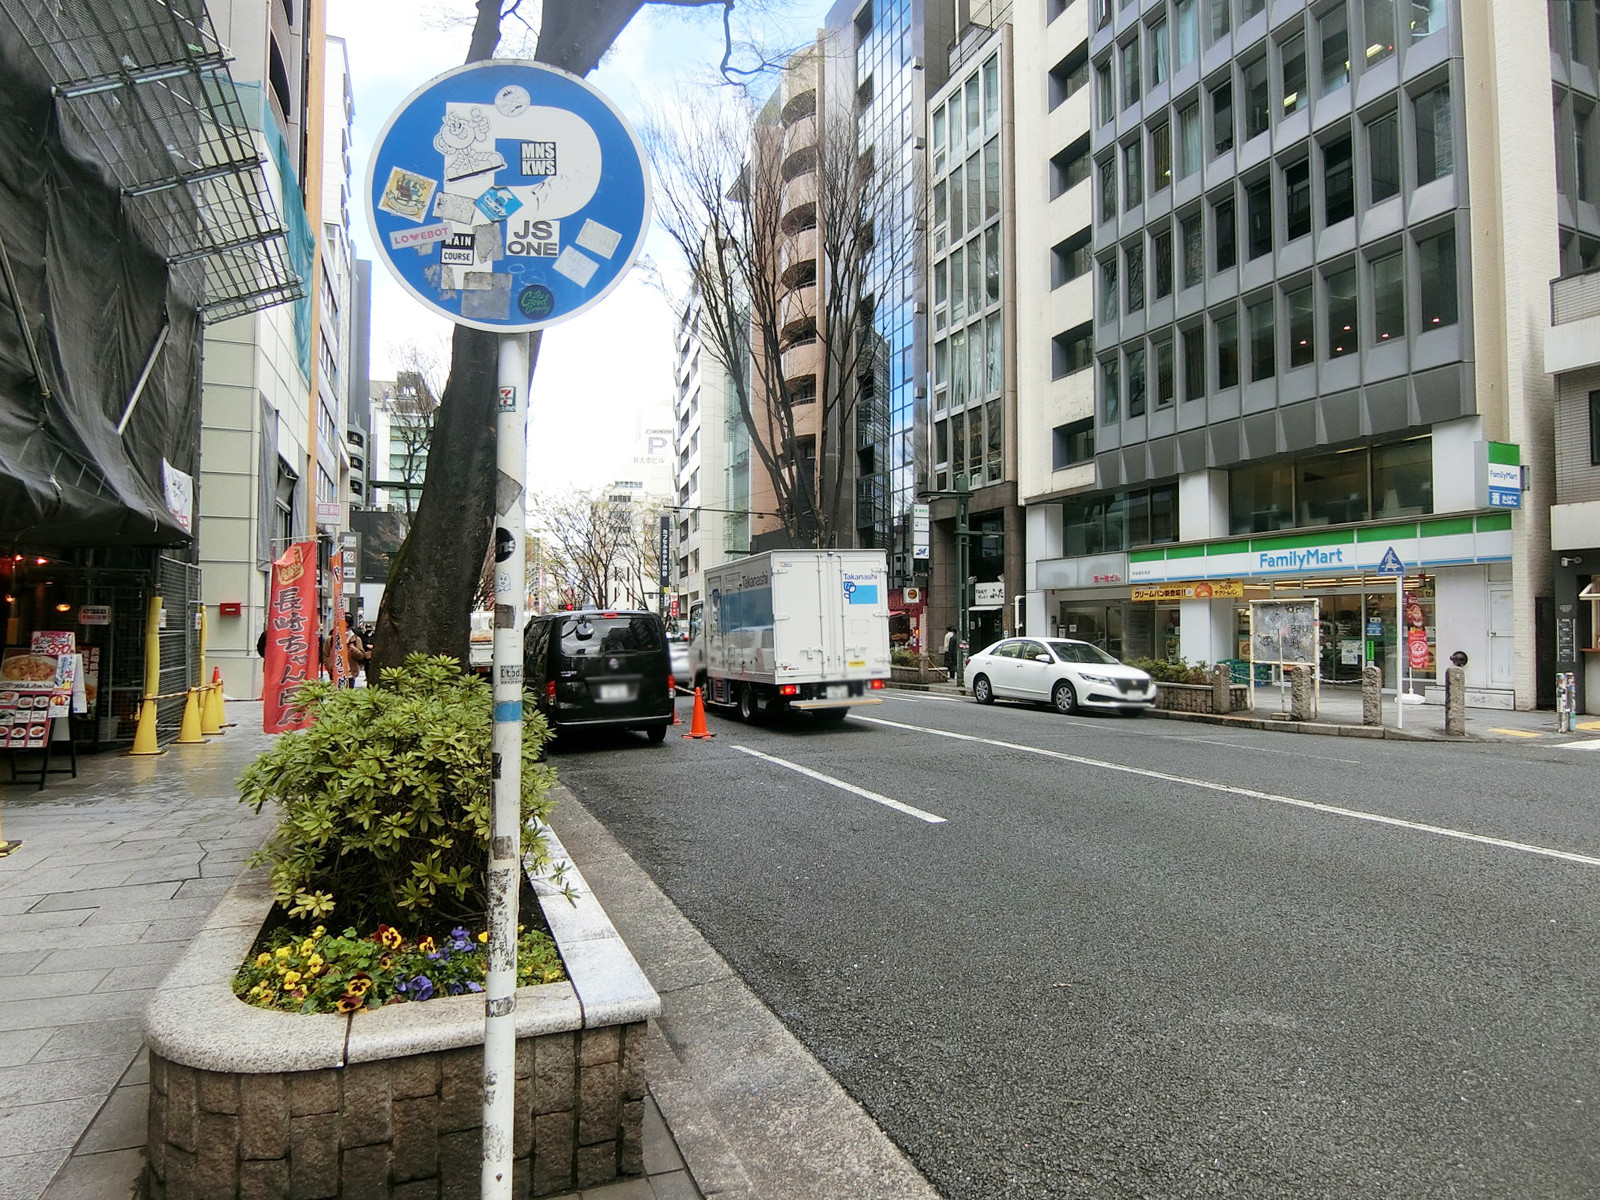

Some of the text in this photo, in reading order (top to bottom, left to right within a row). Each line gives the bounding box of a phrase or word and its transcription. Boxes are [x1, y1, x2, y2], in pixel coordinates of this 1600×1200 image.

[521, 143, 555, 159] MNS
[521, 160, 556, 175] KWS
[513, 220, 553, 241] JS
[443, 252, 471, 261] COURSE
[507, 241, 558, 257] ONE
[647, 436, 668, 454] P
[1489, 469, 1518, 480] FamilyMart
[1501, 493, 1518, 505] たばこ
[1259, 548, 1343, 570] FamilyMart
[742, 571, 769, 589] Takanashi
[843, 573, 878, 581] Takanashi
[46, 643, 72, 654] 390
